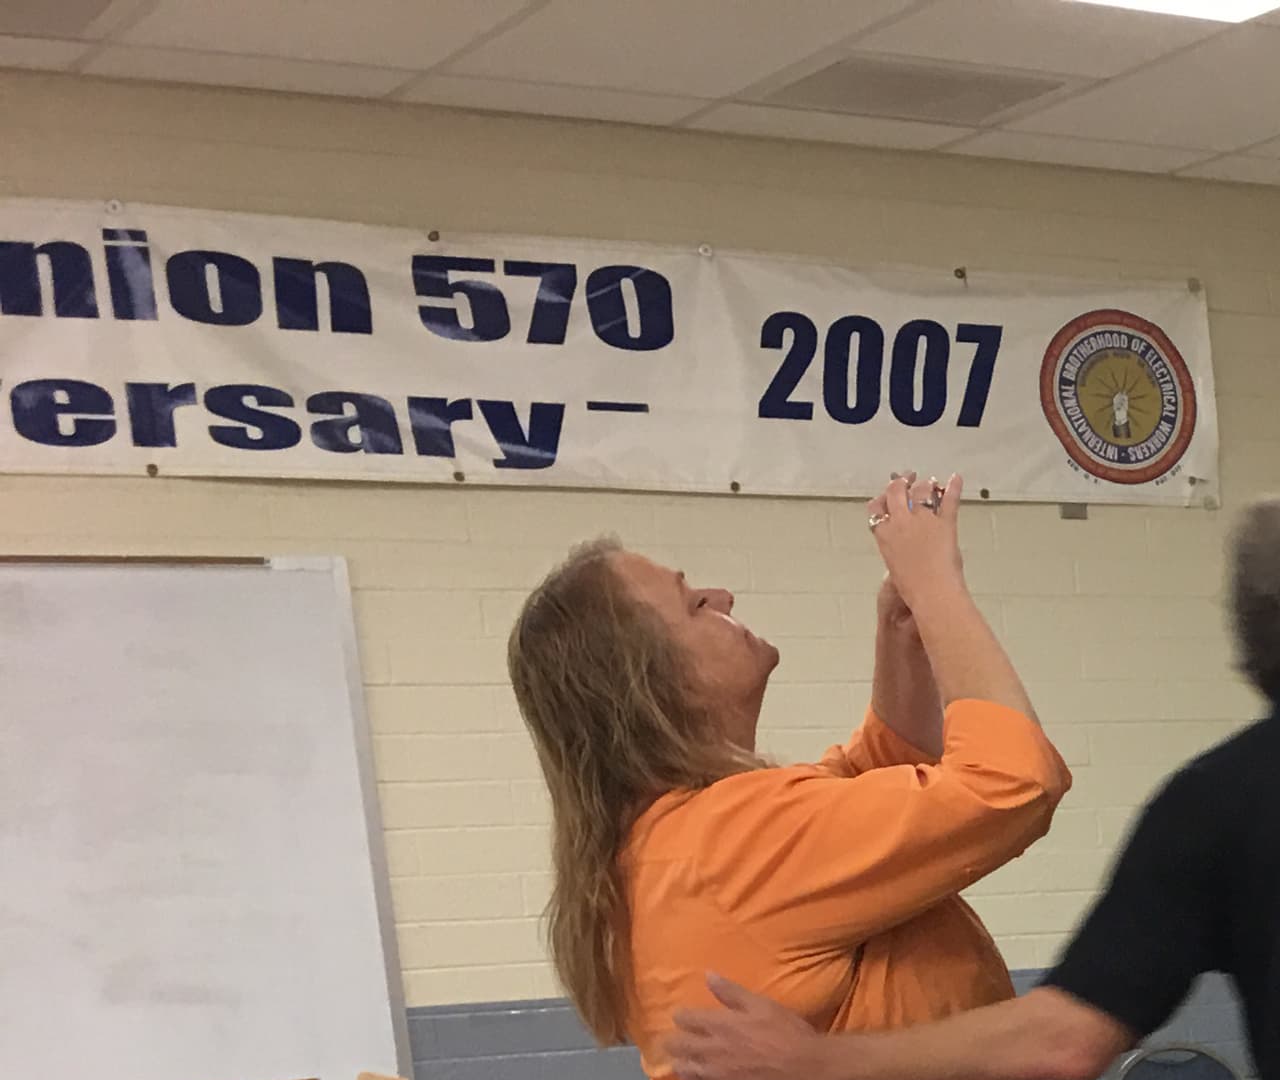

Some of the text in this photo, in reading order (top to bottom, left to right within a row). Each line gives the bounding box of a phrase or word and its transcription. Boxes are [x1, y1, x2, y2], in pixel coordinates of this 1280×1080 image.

[411, 255, 674, 351] 570
[758, 311, 1003, 427] 2007
[1063, 333, 1128, 381] BROTHERHOOD
[1131, 339, 1146, 352] OF
[1145, 349, 1176, 417] ELECTRICAL
[1061, 384, 1118, 461] INTERNATIONAL
